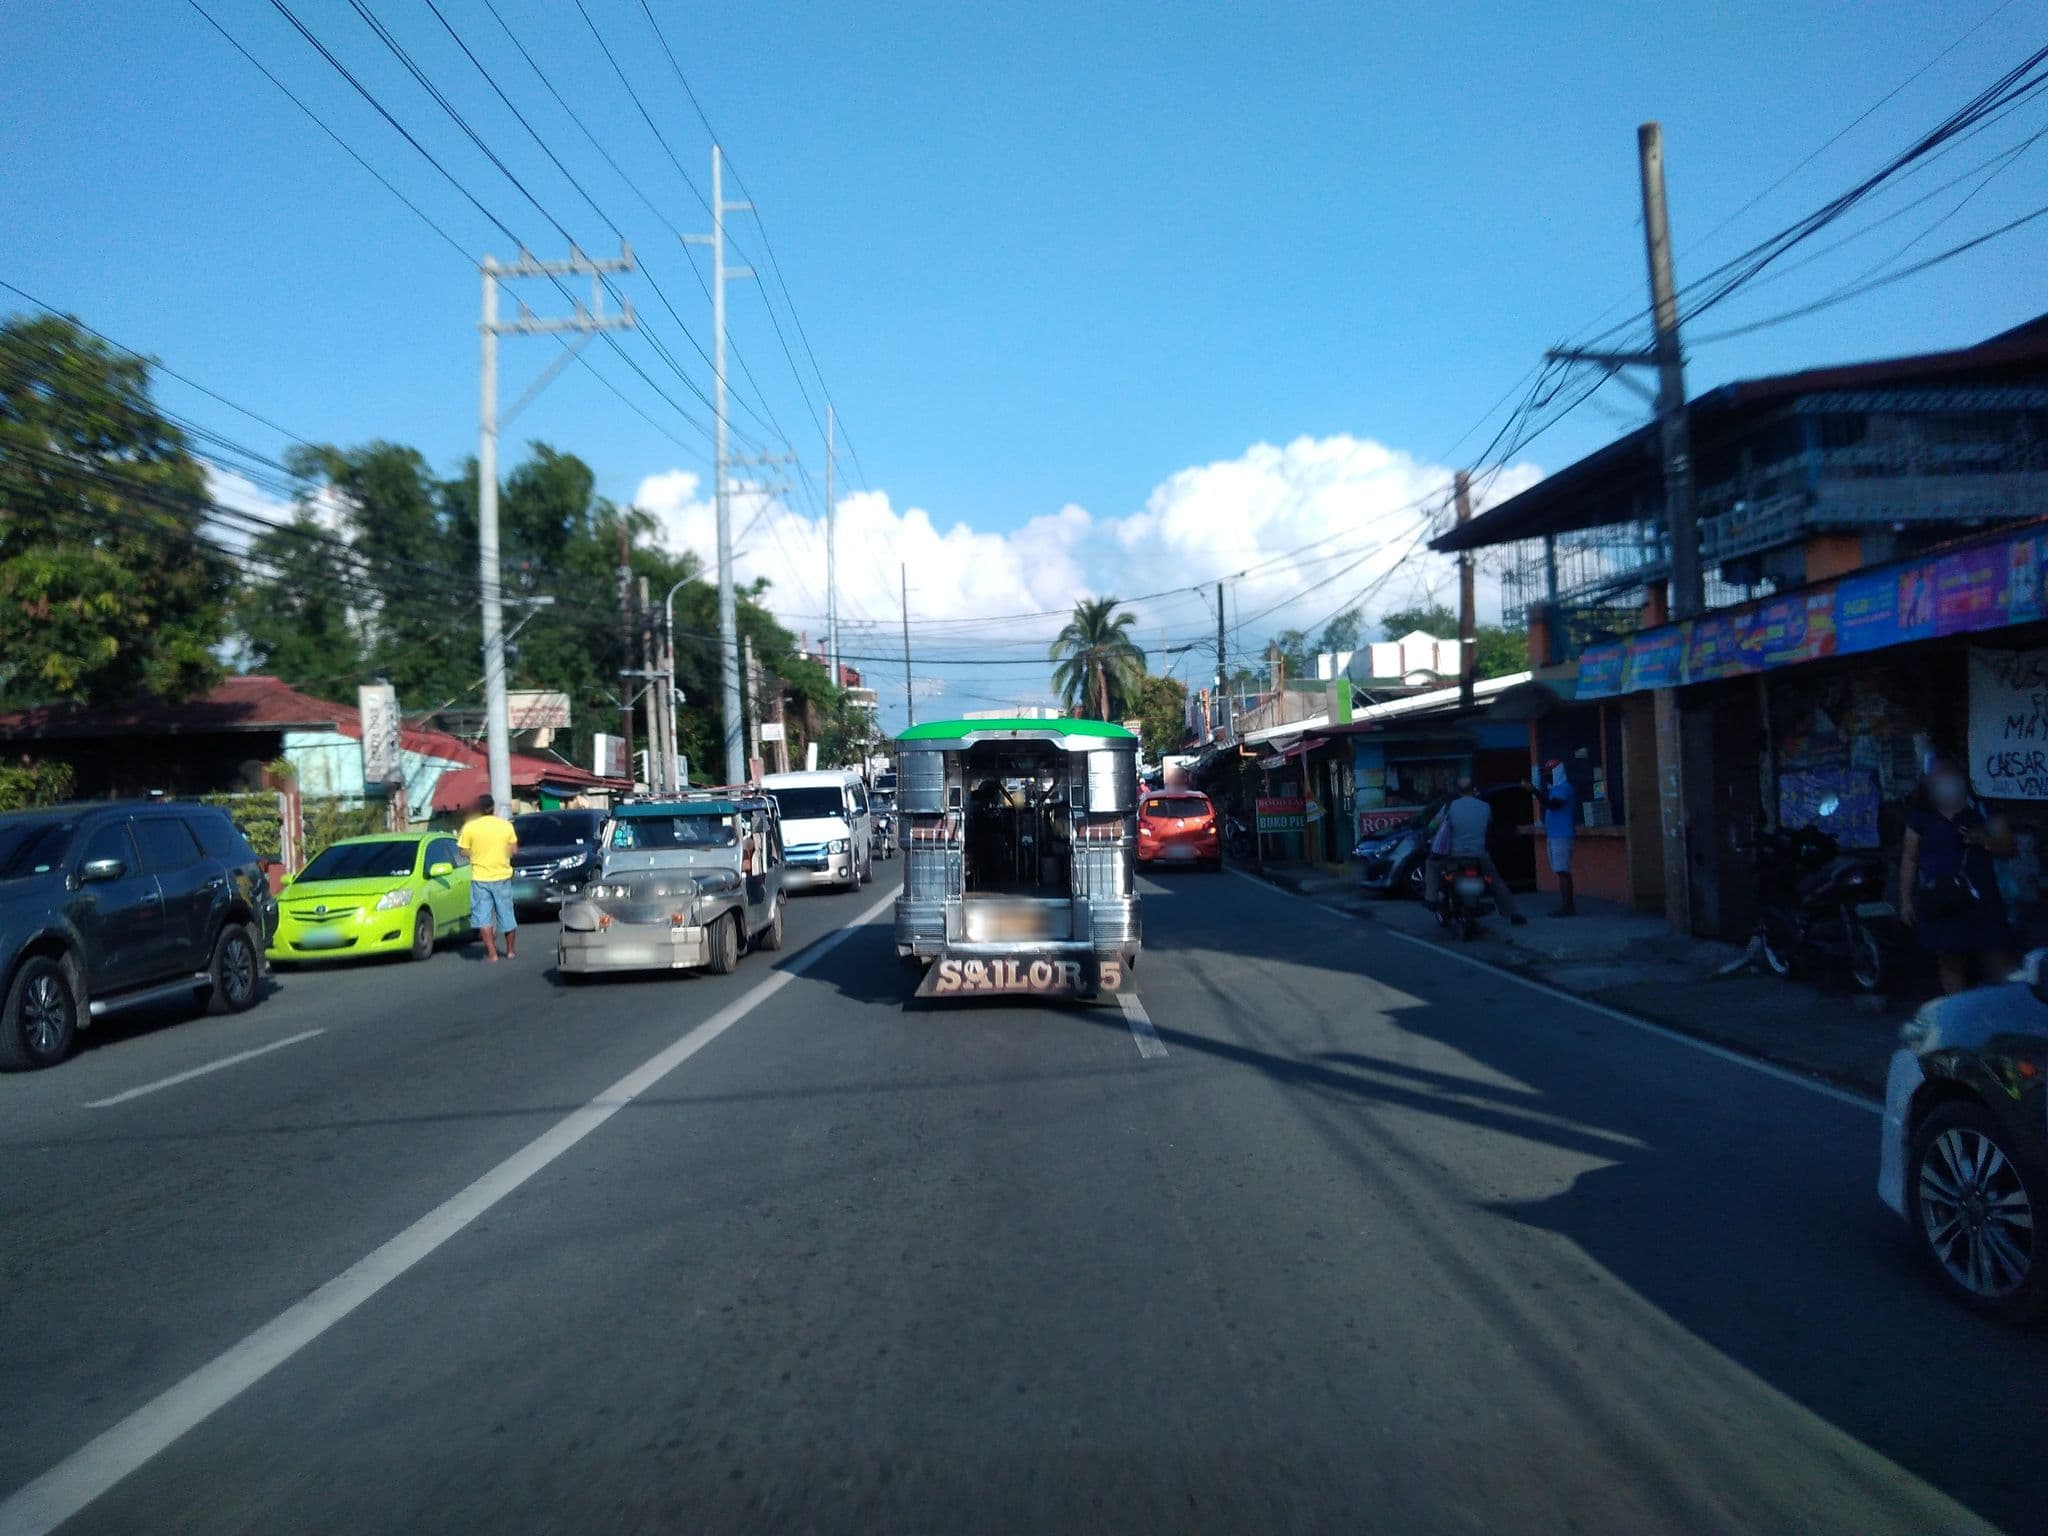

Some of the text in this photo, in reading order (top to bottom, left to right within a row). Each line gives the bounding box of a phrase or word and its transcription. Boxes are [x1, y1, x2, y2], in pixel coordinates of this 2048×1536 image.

[1259, 815, 1305, 829] BUKO PIE
[936, 959, 1122, 993] SAILOR 5
